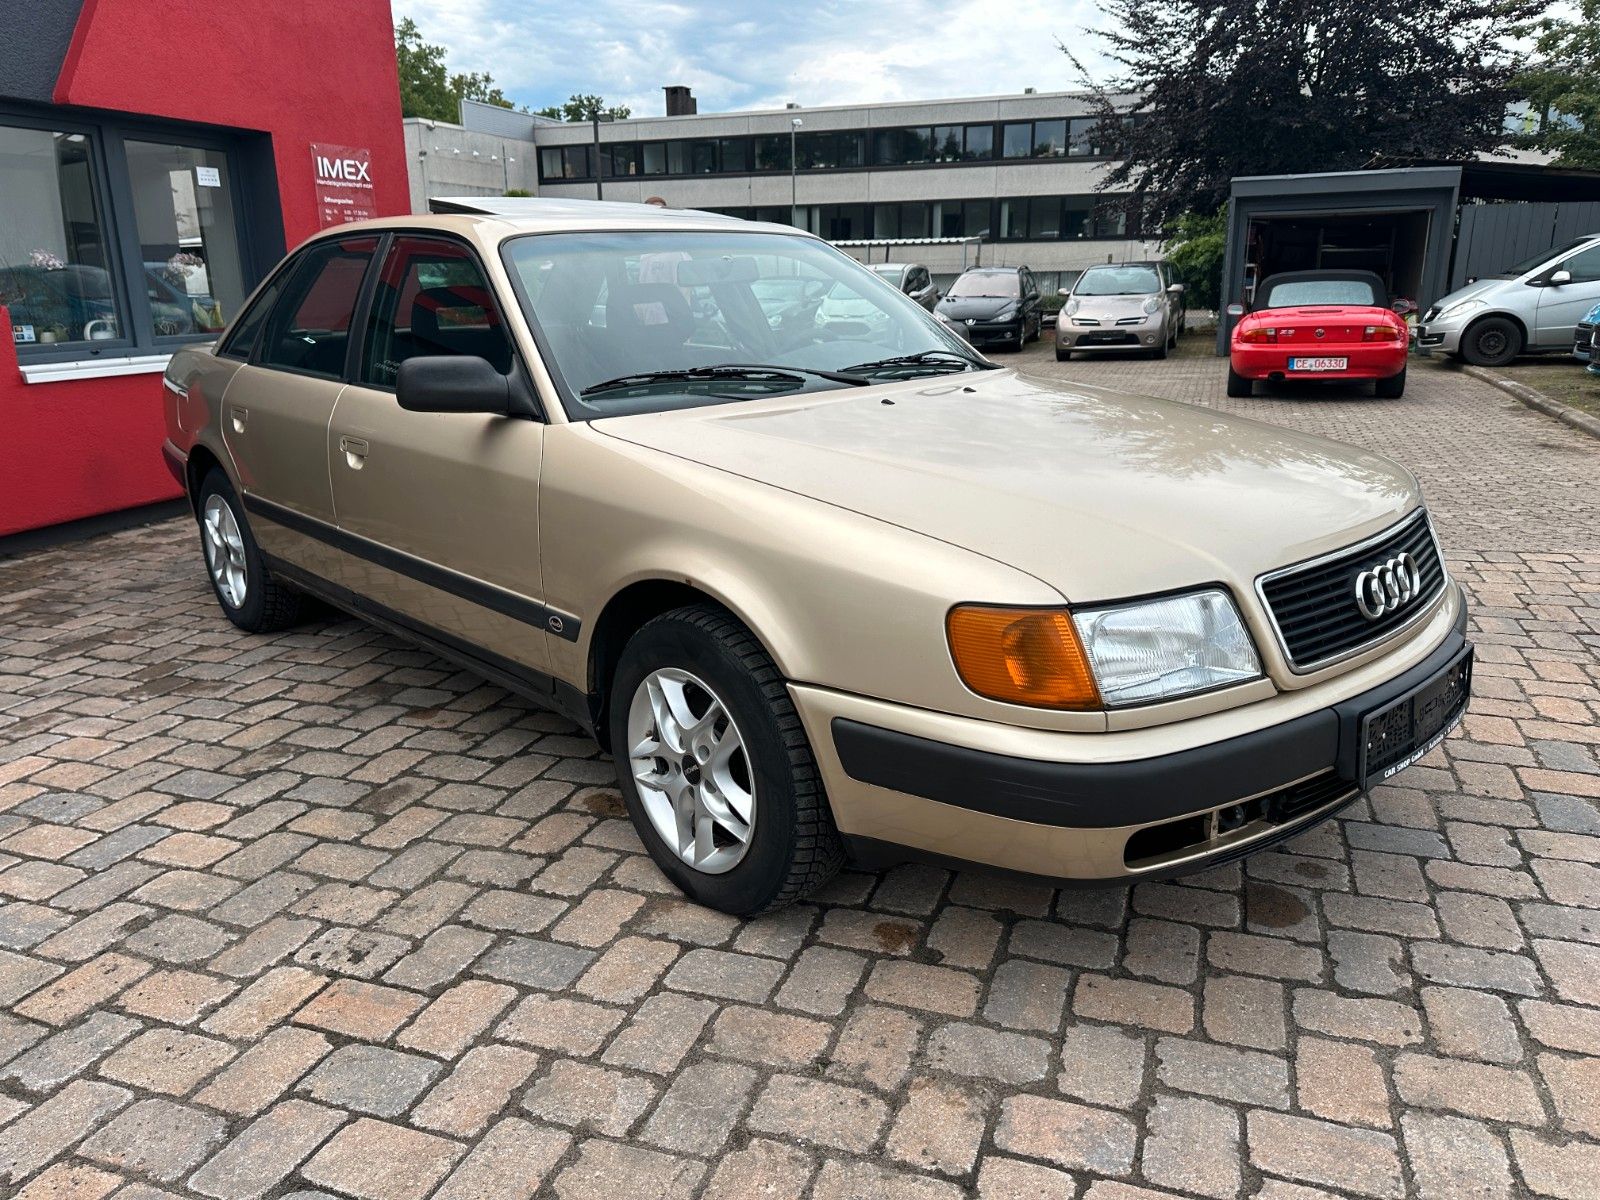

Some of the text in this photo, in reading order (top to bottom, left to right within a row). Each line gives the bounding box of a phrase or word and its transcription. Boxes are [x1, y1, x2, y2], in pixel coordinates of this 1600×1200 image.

[317, 156, 370, 181] IMEX
[1296, 359, 1344, 369] CE 06330
[1384, 767, 1396, 778] CAR
[1396, 758, 1411, 772] SHOP
